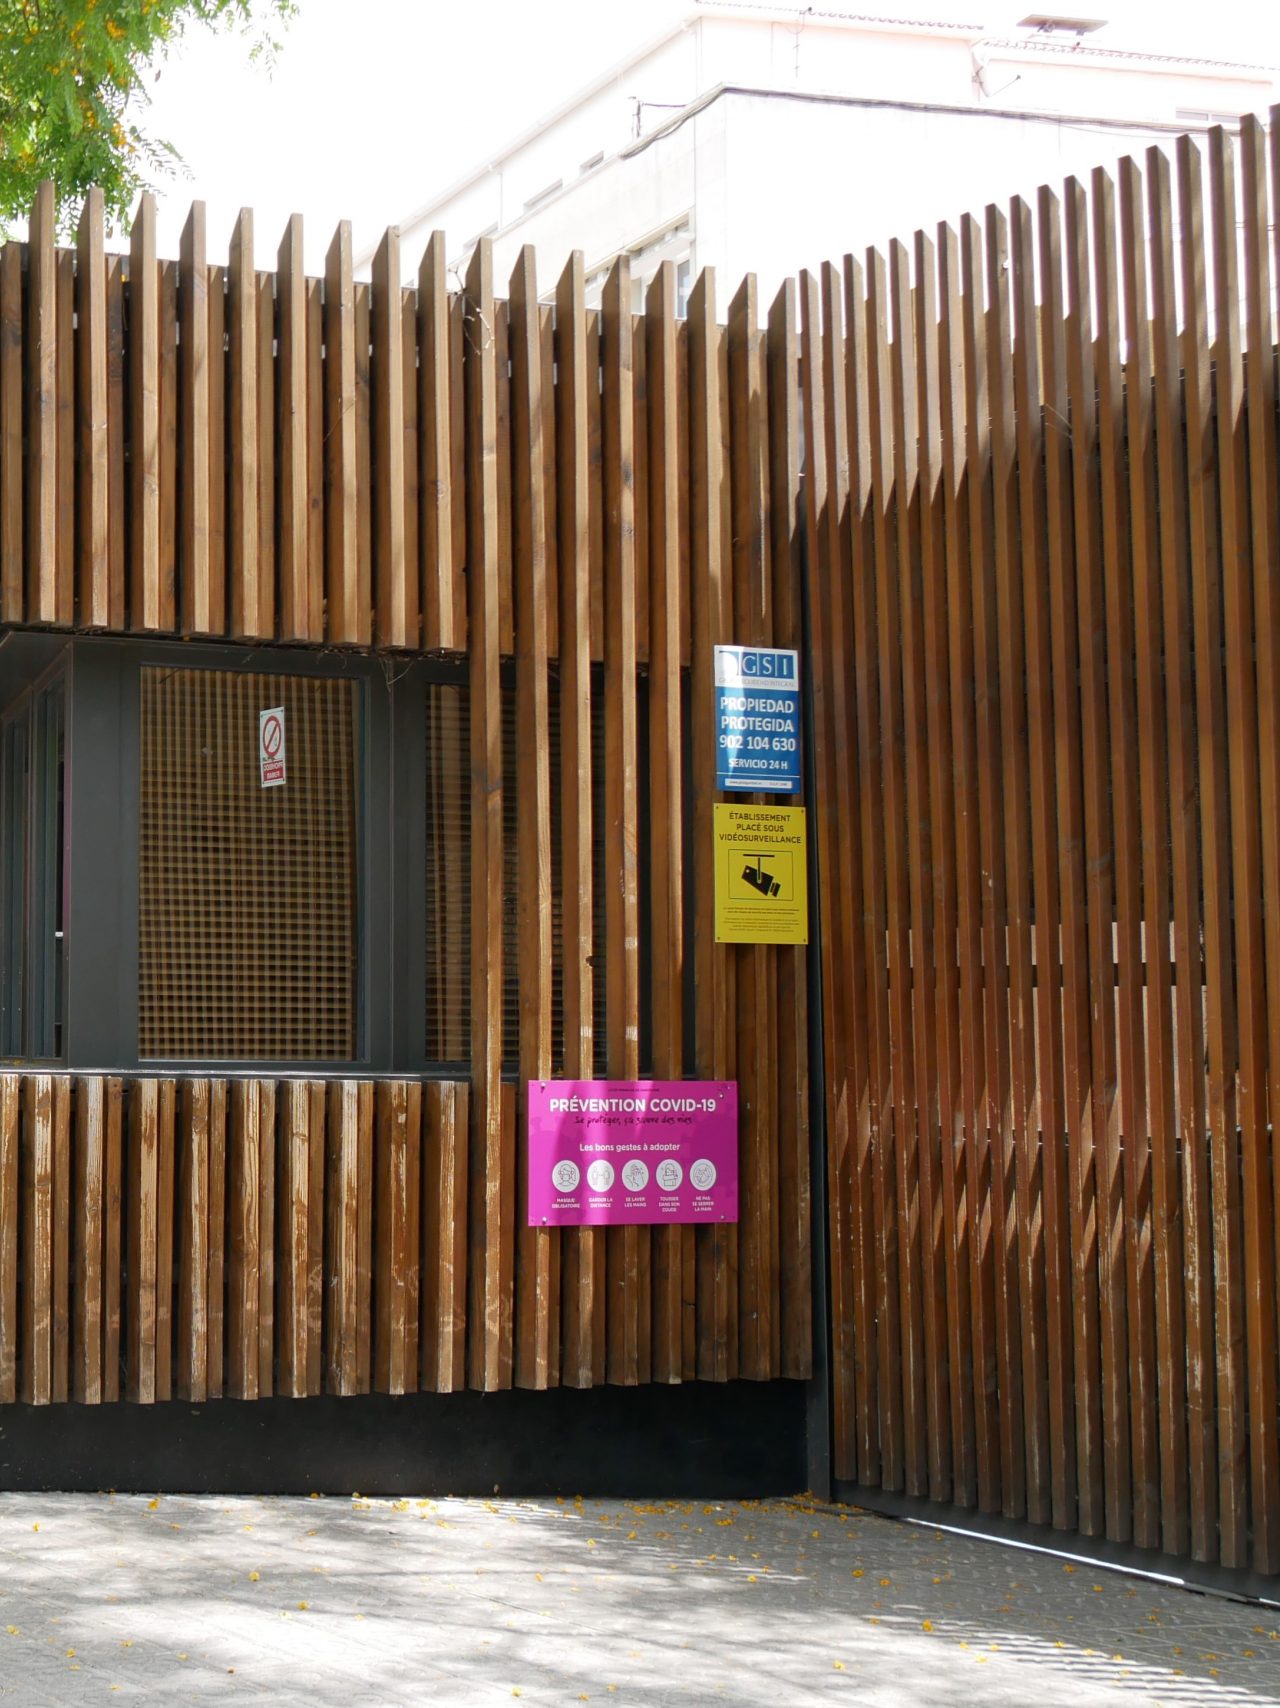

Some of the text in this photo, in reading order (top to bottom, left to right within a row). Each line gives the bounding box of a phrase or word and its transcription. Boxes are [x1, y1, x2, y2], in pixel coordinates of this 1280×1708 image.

[742, 655, 788, 675] GSI
[720, 697, 794, 713] PROPIEDAD
[721, 716, 795, 732] PROTEGIDA
[720, 735, 796, 751] 902 104 630
[728, 758, 788, 770] SERVICIO 24 H
[729, 811, 791, 822] ÉTABLISSEMENT
[736, 822, 785, 833] PLACÉ SOUS
[719, 833, 802, 844] VIDÉOSURVEILLANCE
[549, 1095, 716, 1112] PRÉVENTION COVID-19
[579, 1143, 680, 1153] Les bons gestes à adopter
